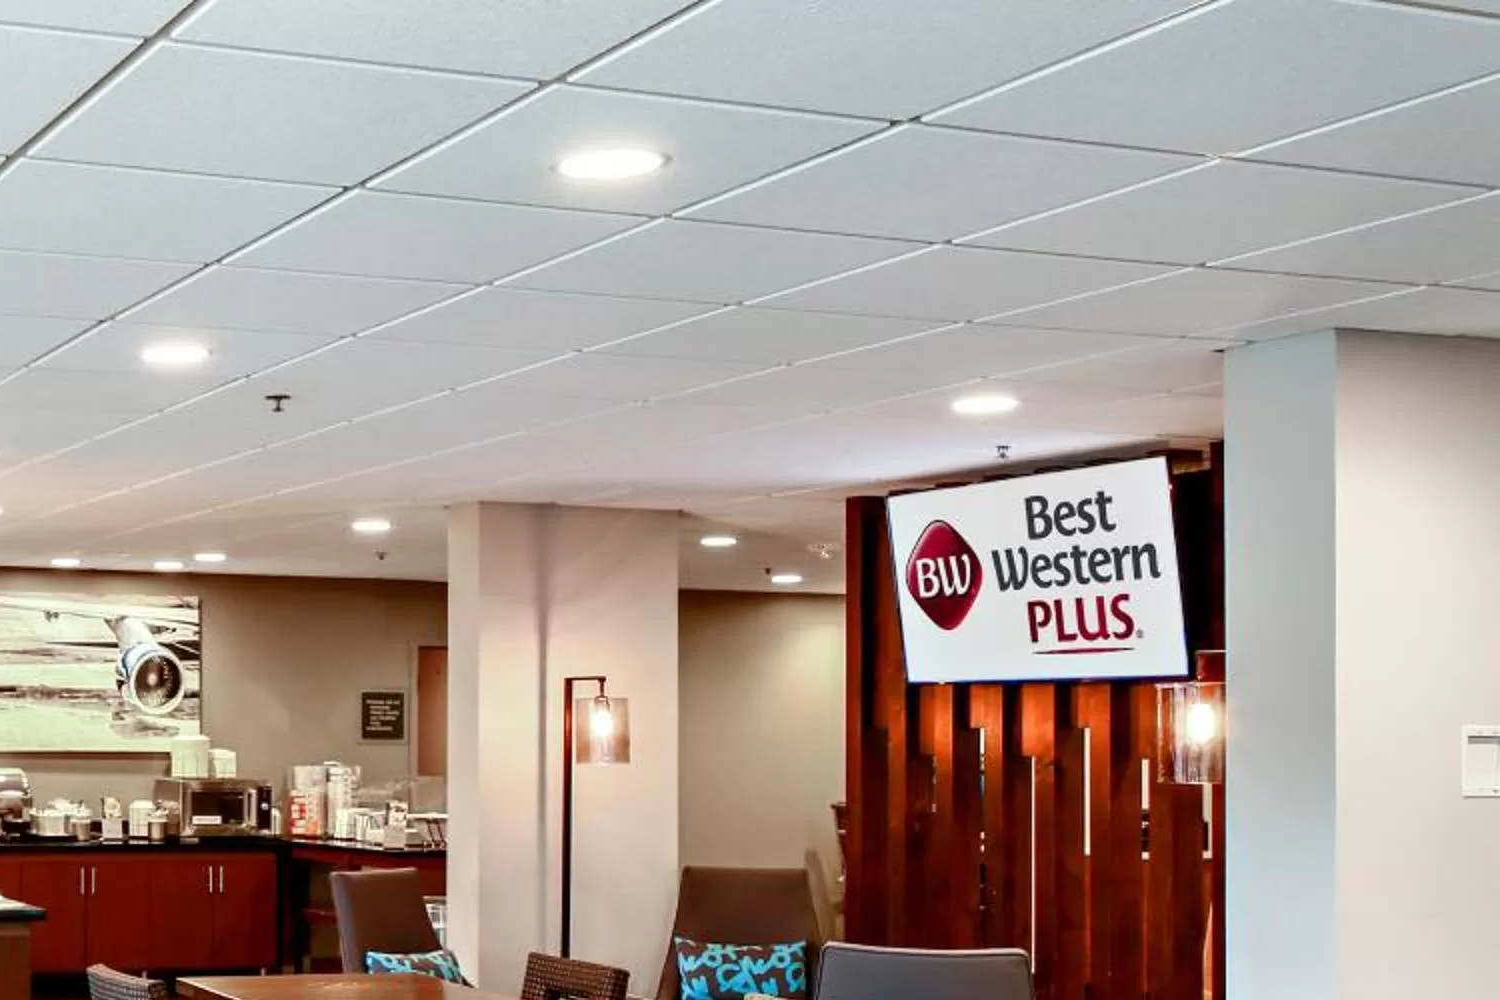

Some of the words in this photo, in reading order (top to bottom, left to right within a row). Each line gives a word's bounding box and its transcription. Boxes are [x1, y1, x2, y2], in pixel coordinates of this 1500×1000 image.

[1024, 491, 1116, 540] Best
[916, 554, 972, 599] BW
[991, 542, 1161, 592] Western
[1027, 593, 1136, 643] PLUS
